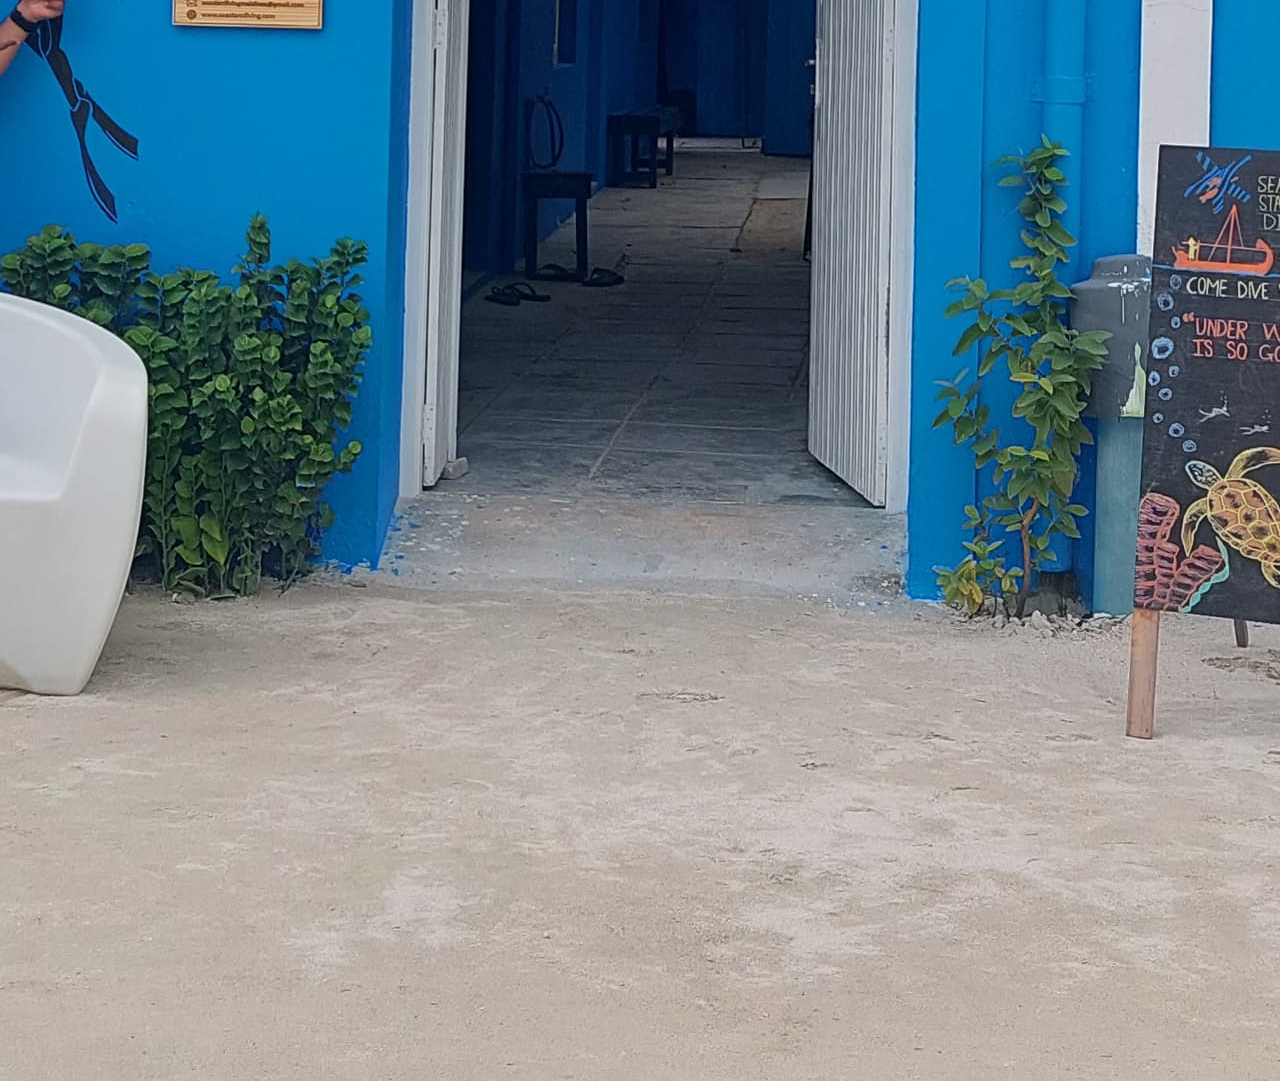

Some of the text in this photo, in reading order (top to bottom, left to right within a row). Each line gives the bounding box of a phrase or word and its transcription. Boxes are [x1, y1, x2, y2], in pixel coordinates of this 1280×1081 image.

[1186, 276, 1228, 298] COME
[1237, 280, 1270, 300] DIVE
[1192, 338, 1214, 358] IS
[1226, 340, 1248, 361] SO
